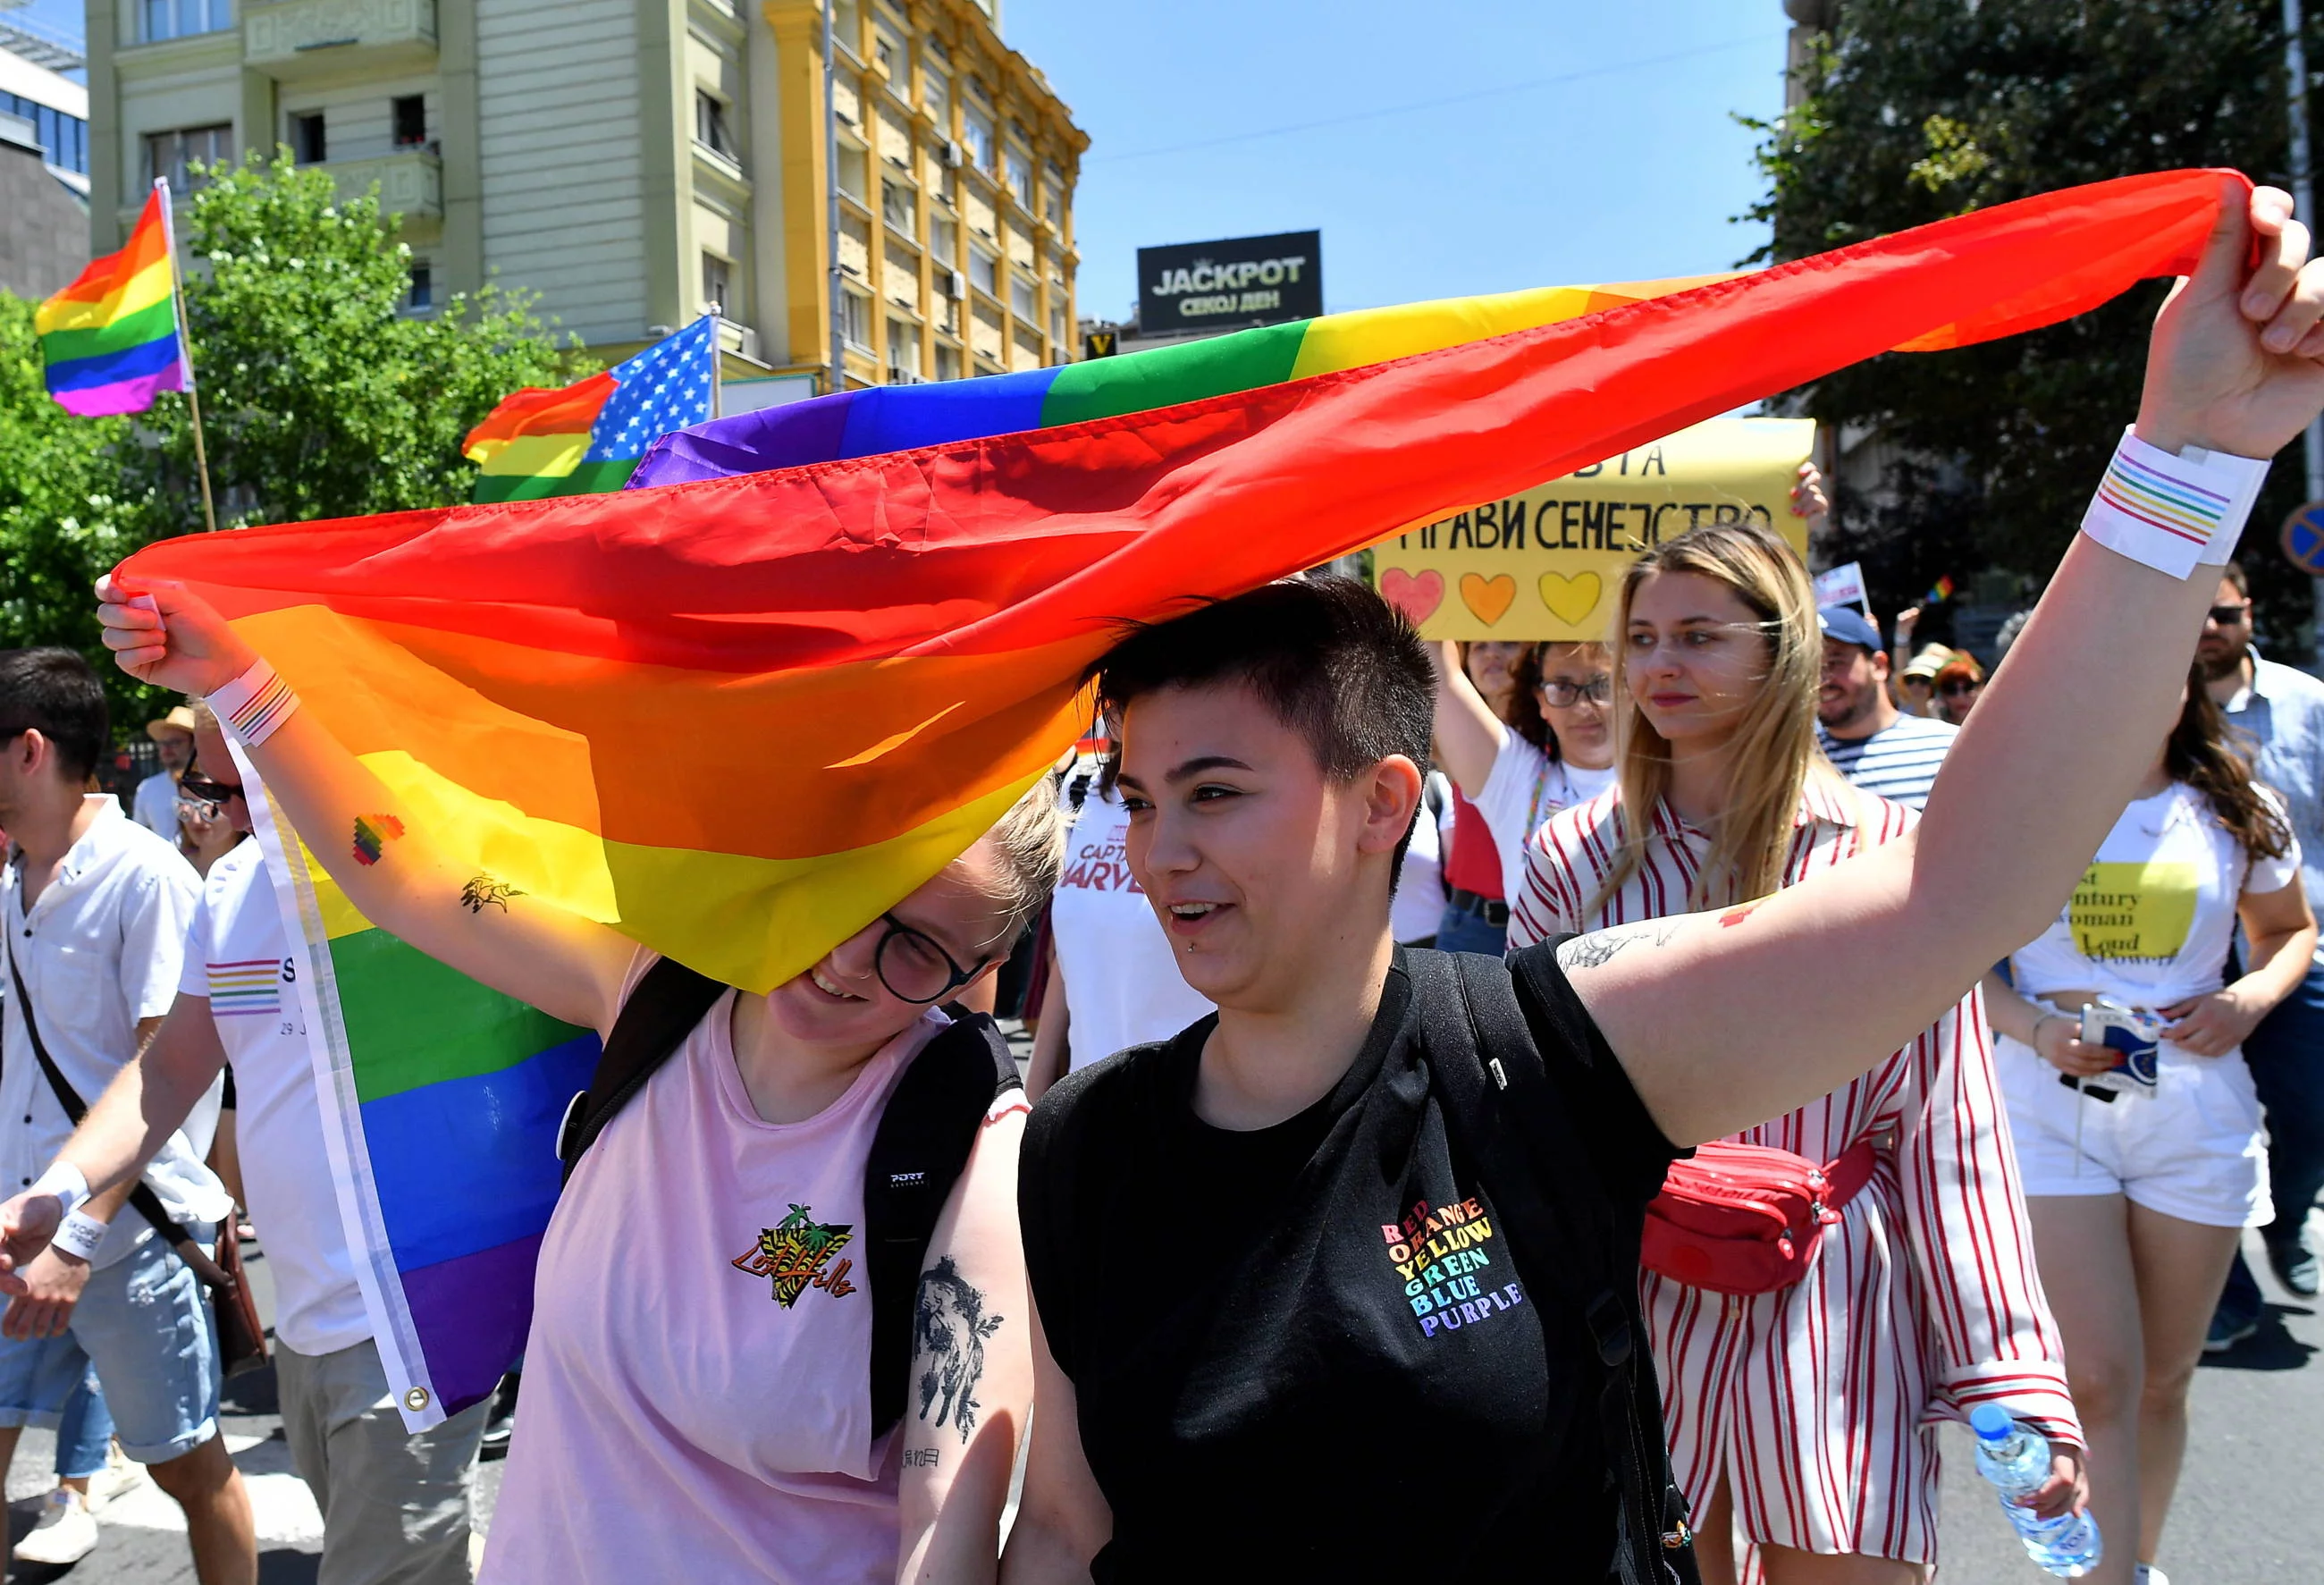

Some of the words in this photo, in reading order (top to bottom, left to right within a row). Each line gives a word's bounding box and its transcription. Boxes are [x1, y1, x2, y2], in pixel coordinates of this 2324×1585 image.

[1151, 256, 1306, 296] JACKPOT
[1091, 334, 1112, 355] V
[1080, 844, 1126, 861] CAPT
[890, 1172, 925, 1182] PORT
[1381, 1200, 1429, 1244] RED
[1388, 1197, 1484, 1262] ORANGE
[1395, 1217, 1493, 1281] YELLOW
[1404, 1247, 1490, 1296] GREEN
[1410, 1276, 1481, 1317] BLUE
[1419, 1283, 1522, 1337] PURPLE
